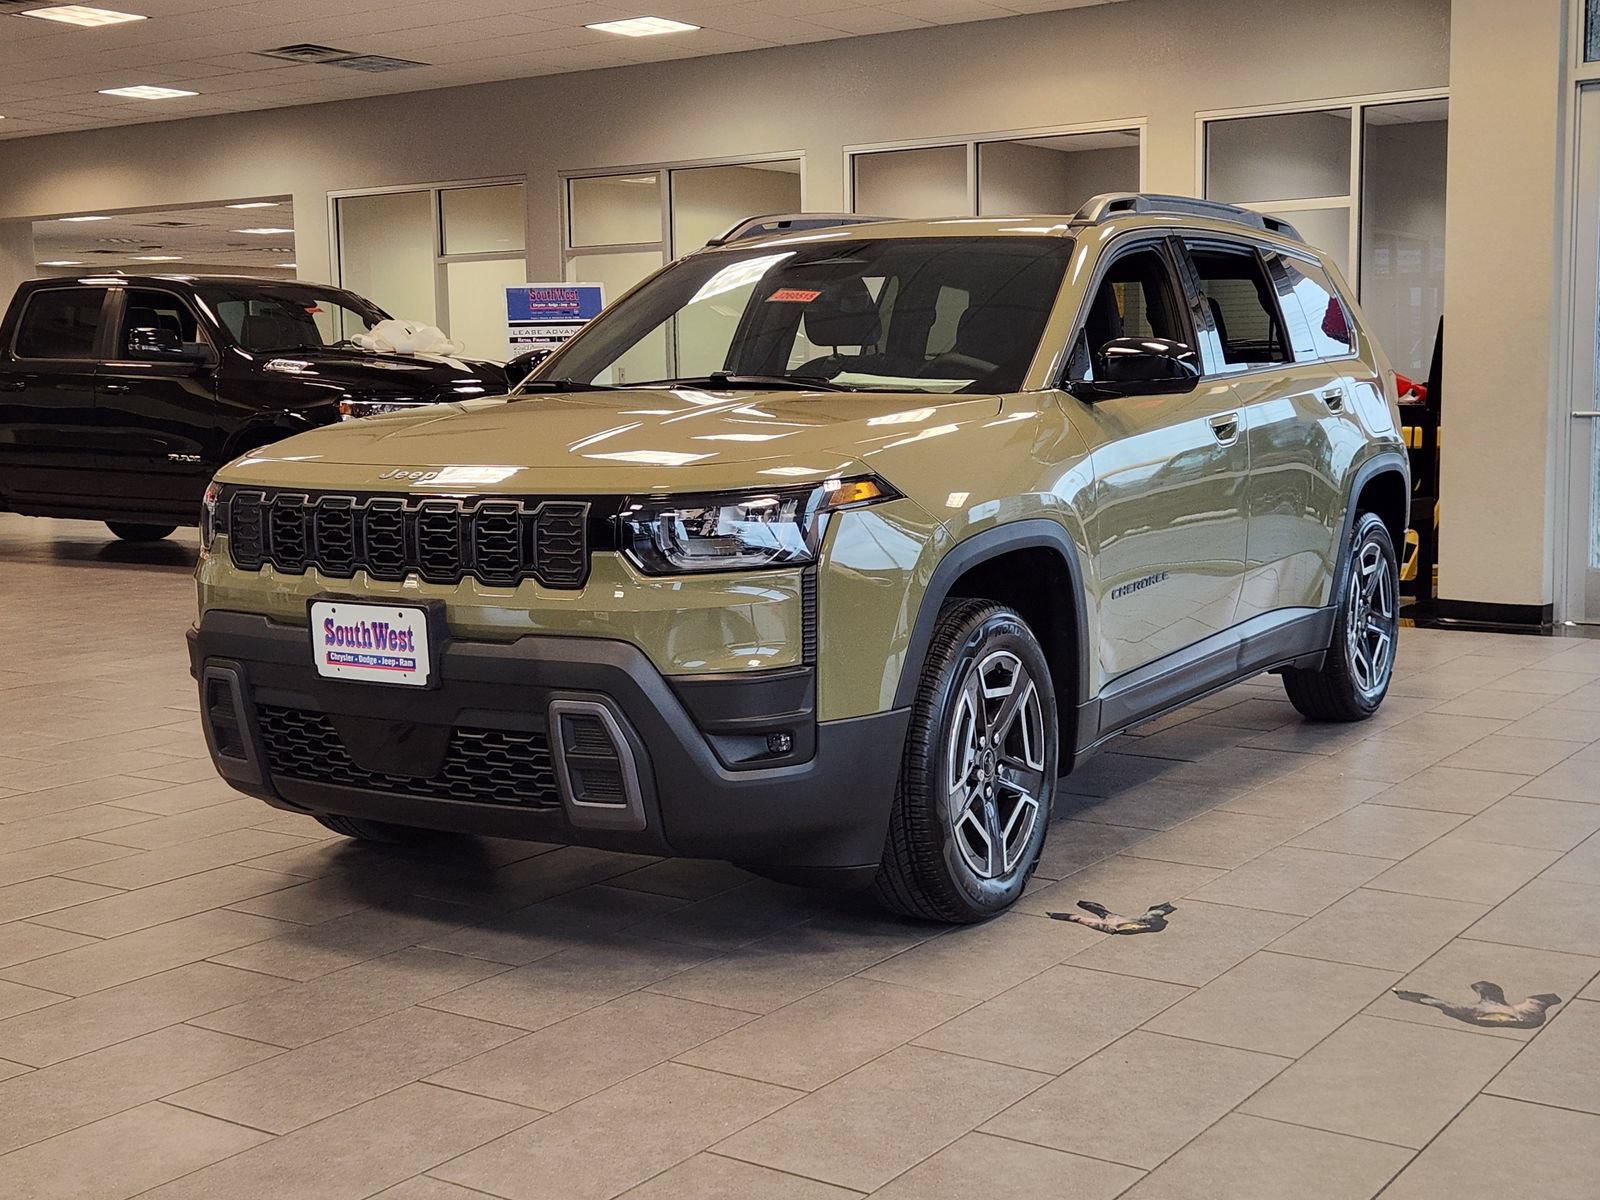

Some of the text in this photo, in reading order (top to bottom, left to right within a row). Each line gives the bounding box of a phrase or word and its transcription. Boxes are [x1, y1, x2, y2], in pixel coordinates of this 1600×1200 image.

[529, 288, 580, 301] SouthWest
[167, 453, 201, 463] RAM
[378, 468, 439, 484] Jeep
[1111, 570, 1170, 600] CHEROKEE
[323, 617, 416, 653] SouthWest
[330, 652, 414, 668] Chrysler Dodge Jeep Ram
